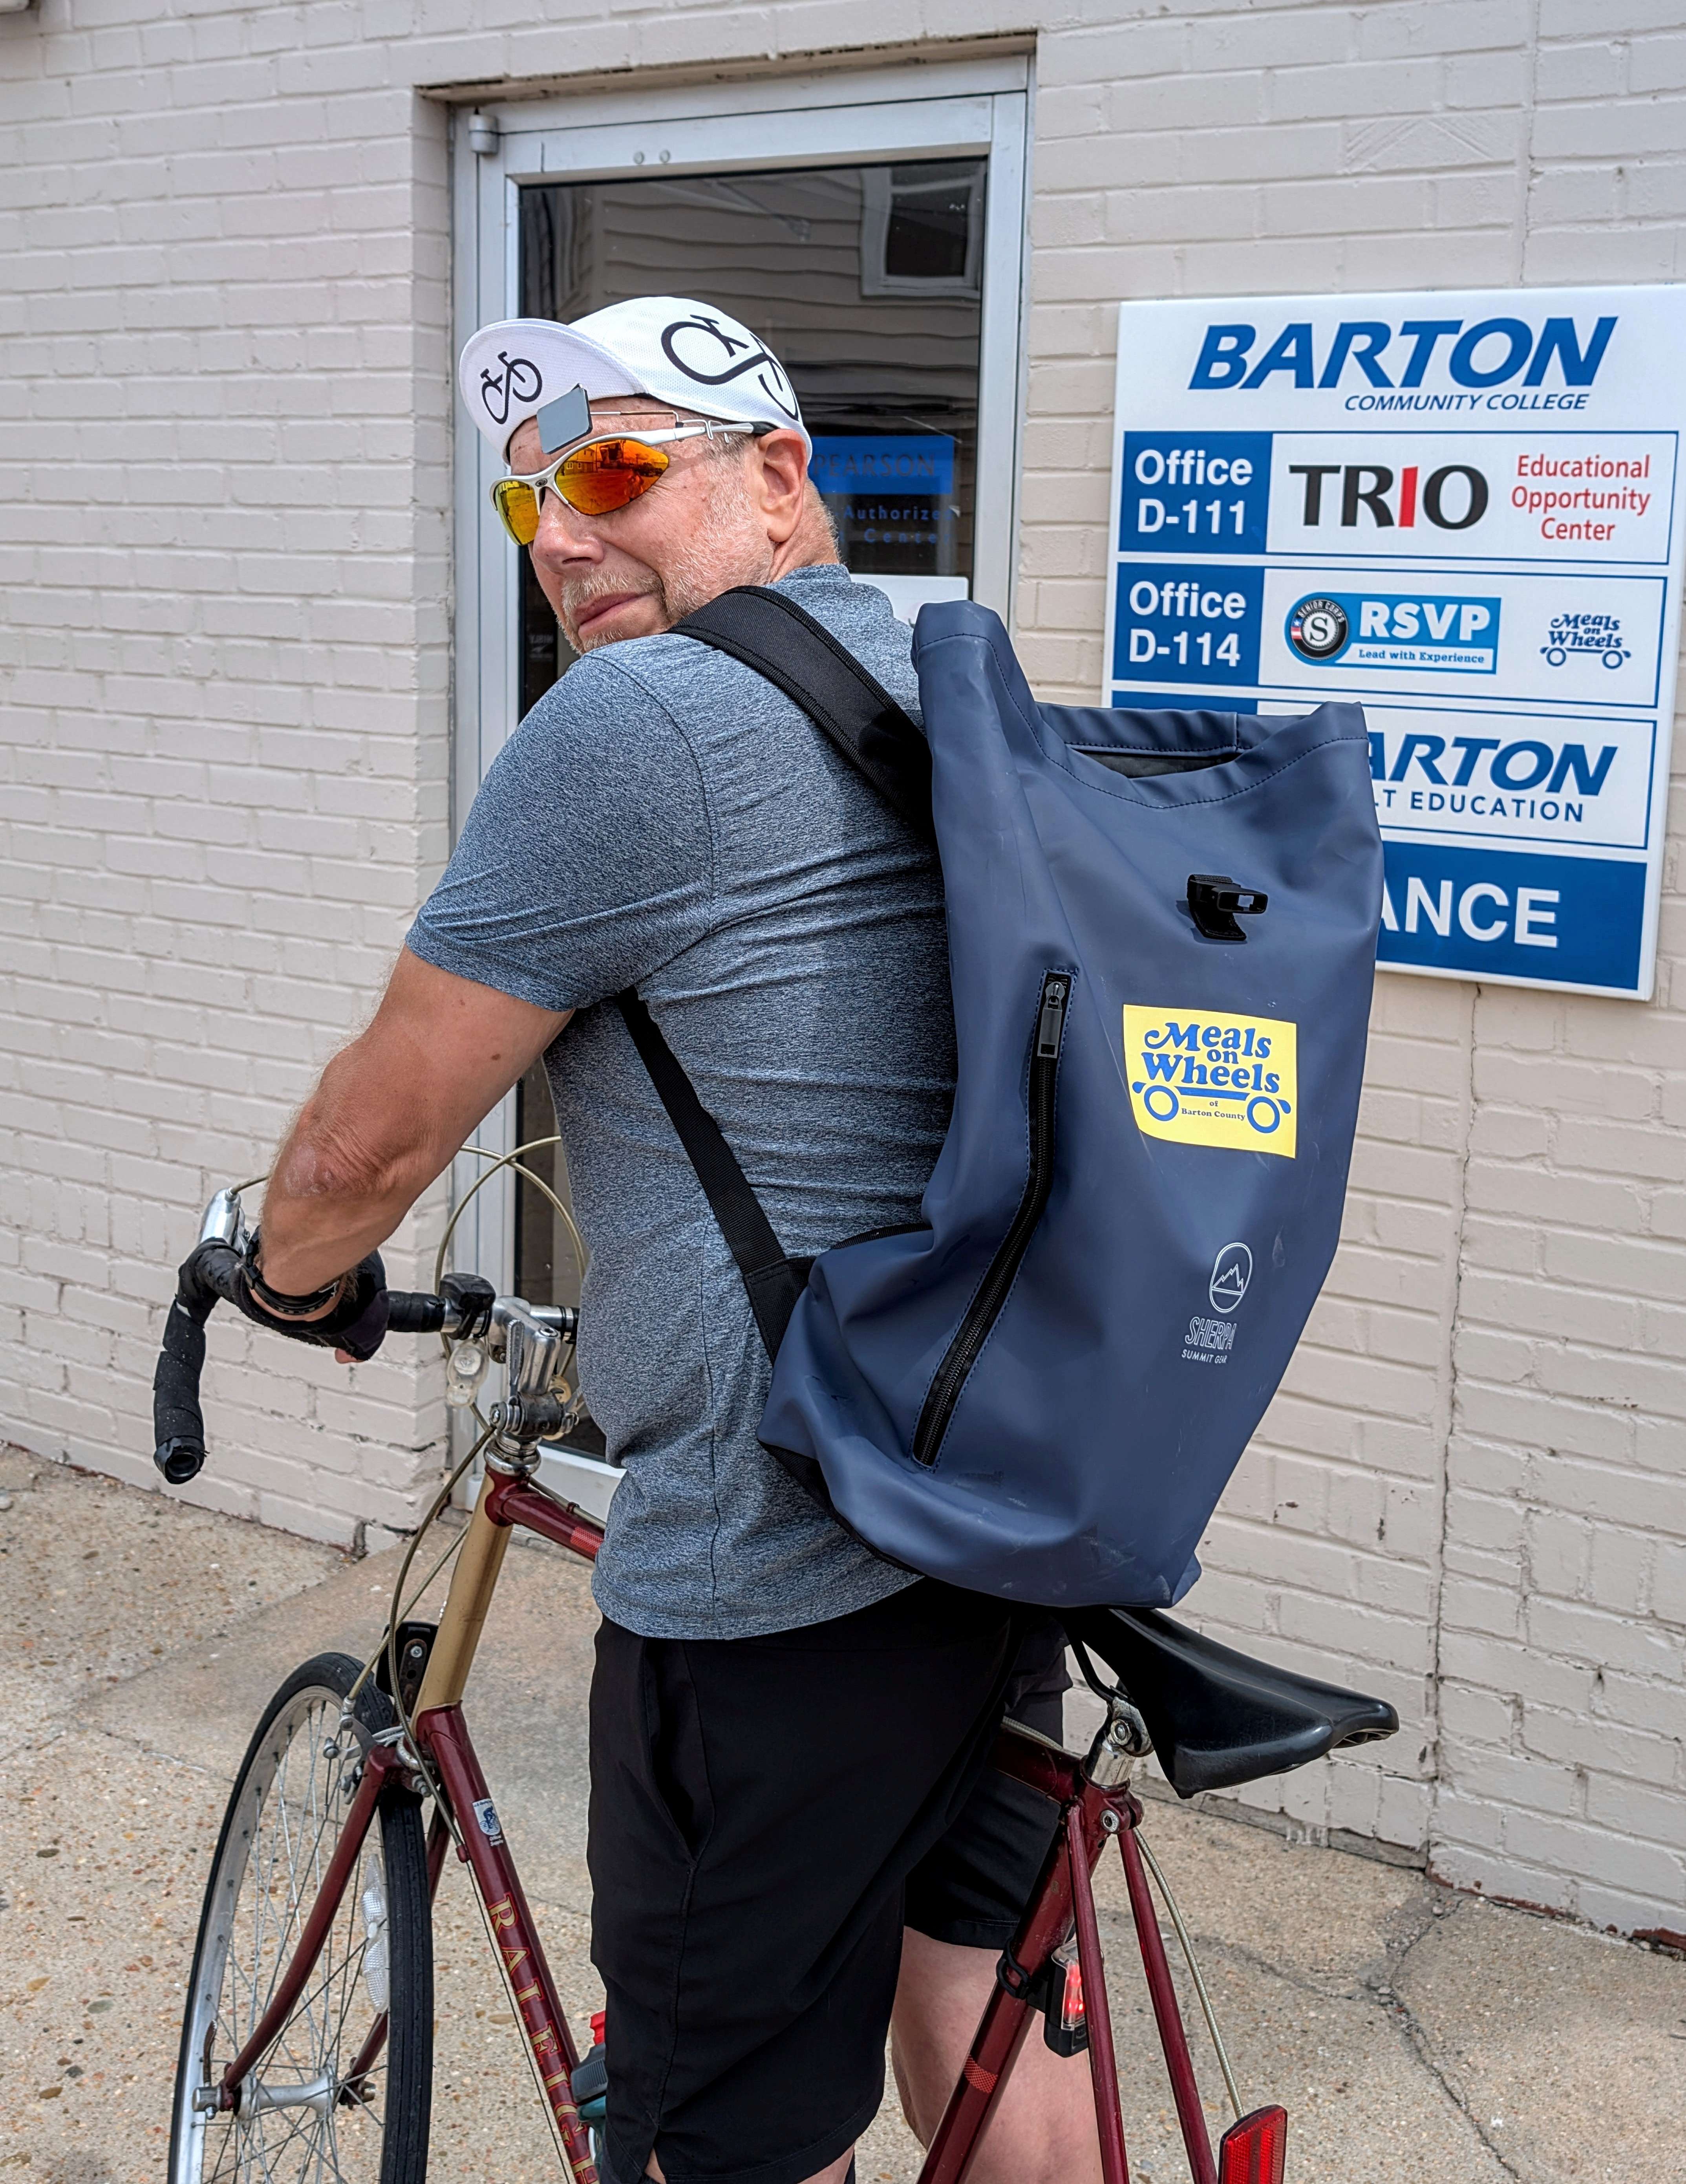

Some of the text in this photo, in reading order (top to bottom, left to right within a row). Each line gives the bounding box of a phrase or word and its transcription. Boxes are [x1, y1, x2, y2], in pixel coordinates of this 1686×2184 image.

[1188, 316, 1618, 390] BARTON
[1345, 394, 1589, 410] COMMUNITY COLLEGE
[813, 454, 935, 478] PEARSON
[1135, 449, 1253, 485] Office
[1518, 454, 1649, 478] Educational
[1289, 465, 1489, 530] TRIO
[1512, 486, 1650, 516] Opportunity
[1138, 499, 1245, 534] D-111
[1541, 517, 1615, 541] Center
[864, 528, 951, 544] Center
[1130, 581, 1246, 619] Office
[1297, 600, 1345, 622] SENIOR CORPS
[1309, 617, 1328, 642] S
[1360, 601, 1490, 641] RSVP
[1551, 613, 1620, 631] Meals
[1129, 629, 1240, 667] D-114
[1548, 630, 1622, 648] Wheels
[1359, 649, 1485, 663] Lead with Experience
[1410, 791, 1583, 822] EDUCATION
[1144, 1022, 1271, 1059] Meals
[1207, 1049, 1239, 1064] on
[1141, 1052, 1280, 1093] Wheels
[1181, 1108, 1245, 1121] Barton County
[1185, 1316, 1237, 1350] SHERPA
[1181, 1349, 1228, 1364] SUMMIT GEAR
